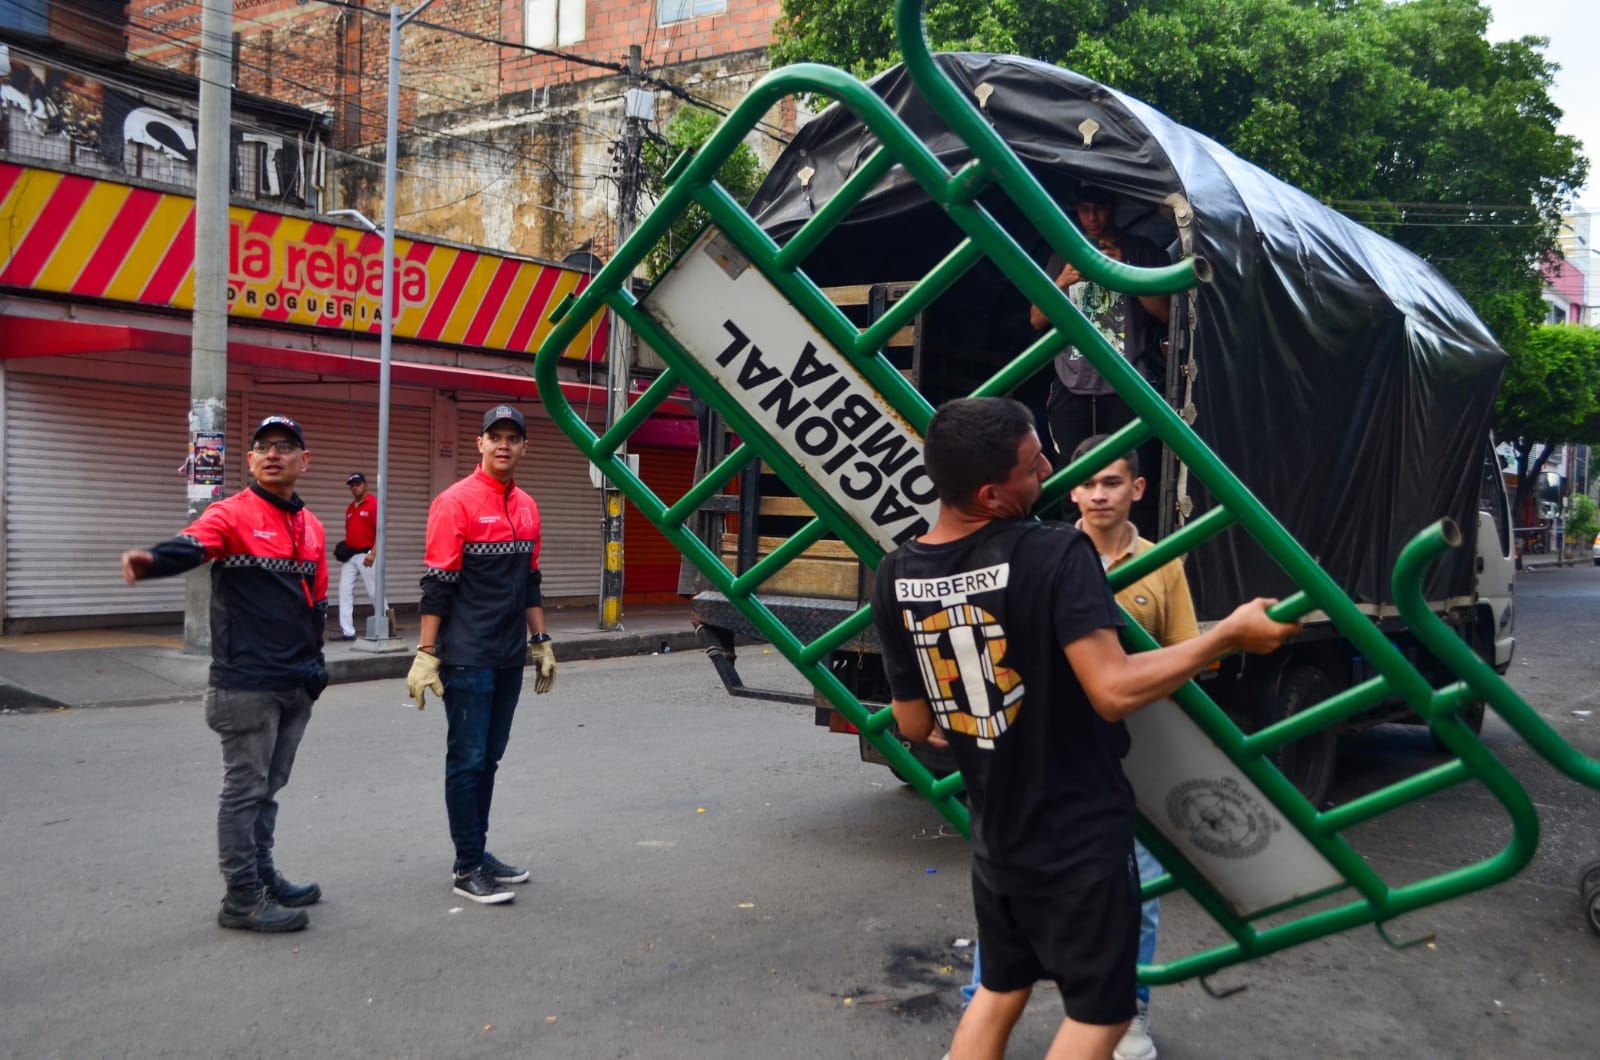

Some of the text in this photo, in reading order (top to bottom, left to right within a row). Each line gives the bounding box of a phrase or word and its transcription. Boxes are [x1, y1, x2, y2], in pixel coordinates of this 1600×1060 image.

[229, 223, 426, 319] la rebaja
[227, 287, 383, 321] DROGUERIA
[900, 568, 1000, 599] BURBERRY
